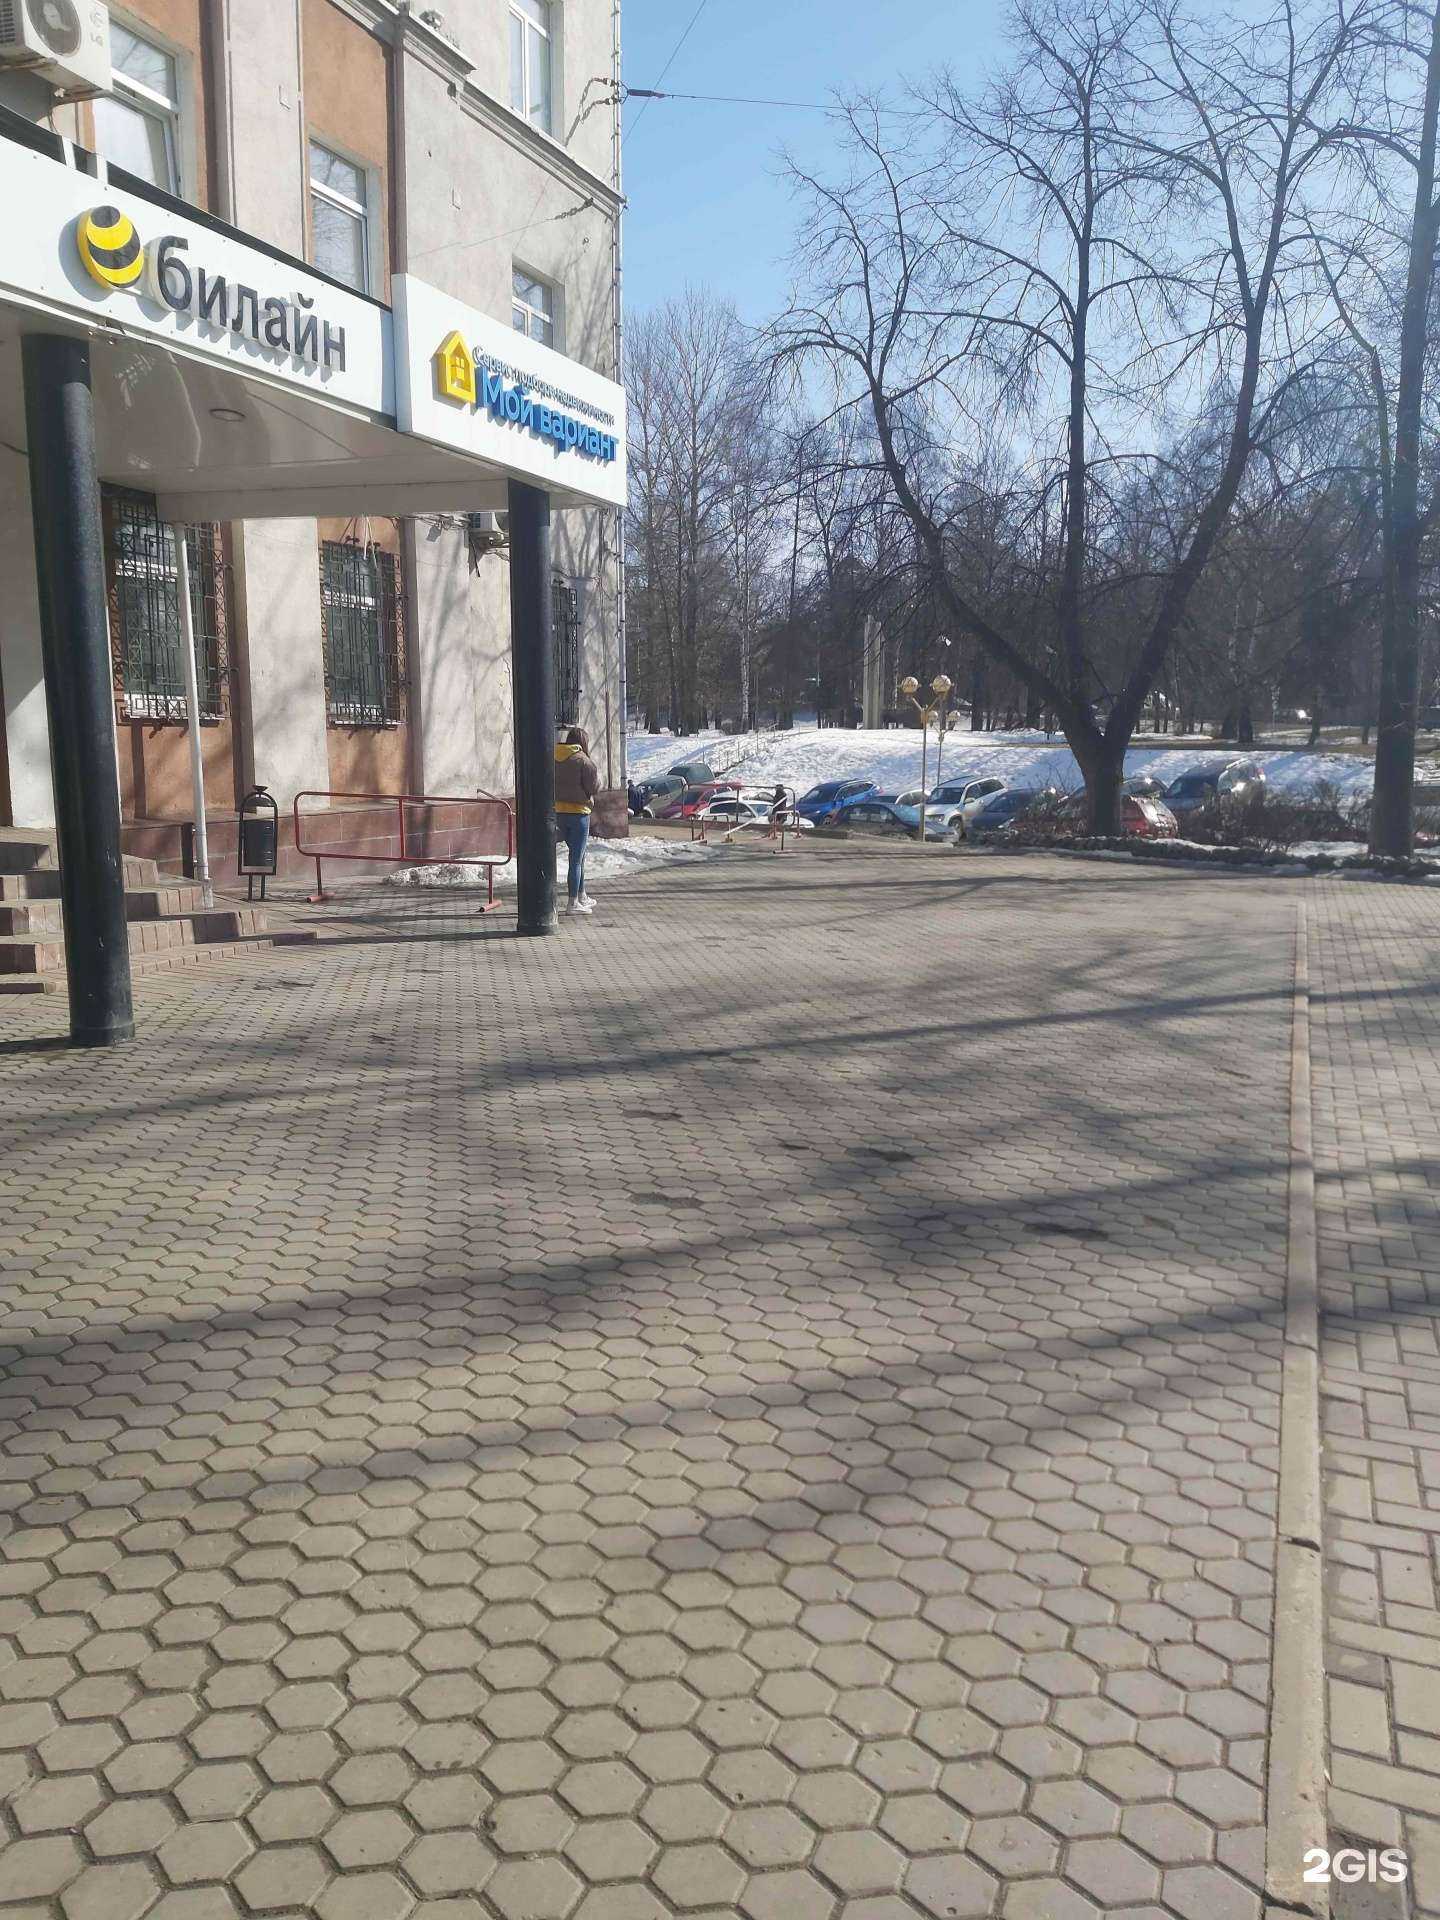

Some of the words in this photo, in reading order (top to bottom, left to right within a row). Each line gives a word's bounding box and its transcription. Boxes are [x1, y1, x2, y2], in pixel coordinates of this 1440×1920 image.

[156, 235, 346, 373] билайн
[480, 366, 534, 427] Мой
[539, 406, 620, 462] вариант
